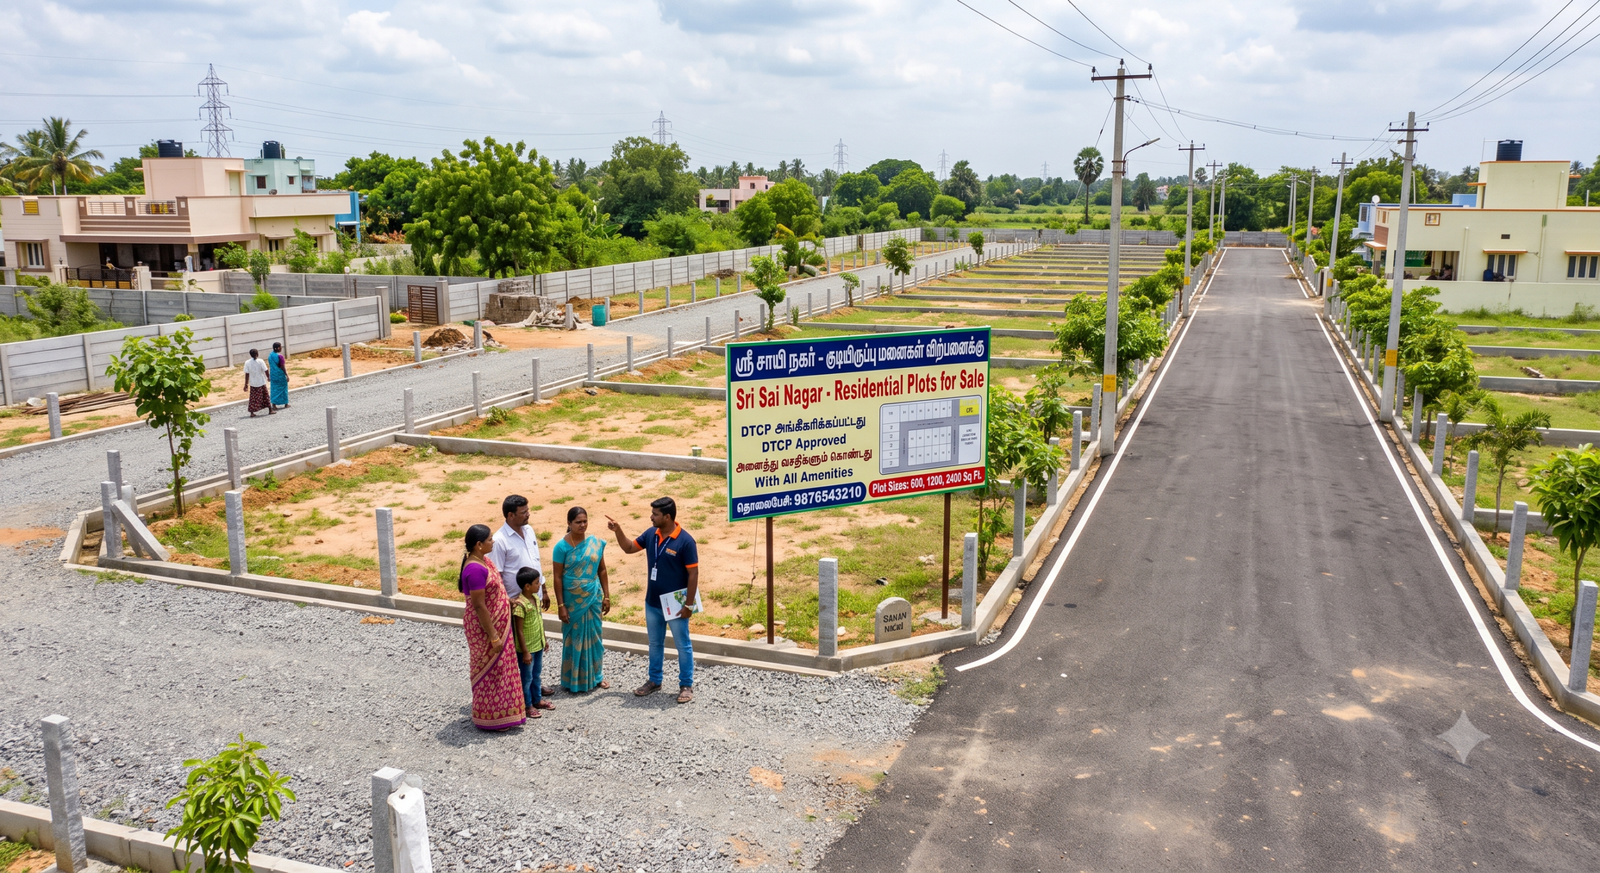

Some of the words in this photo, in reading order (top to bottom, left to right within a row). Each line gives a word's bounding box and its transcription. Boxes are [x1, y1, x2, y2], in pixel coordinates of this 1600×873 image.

[756, 348, 787, 371] சாயி
[788, 346, 816, 374] நகர்
[826, 342, 877, 369] குடியிருப்பு
[878, 339, 925, 361] மனைகள்
[926, 335, 985, 363] விற்பனைக்கு
[736, 387, 755, 410] Sri
[759, 385, 780, 408] Sai
[784, 383, 823, 409] Nagar
[834, 374, 903, 401] Residential
[907, 373, 937, 394] Plots
[940, 370, 957, 391] for
[959, 368, 985, 389] Sale
[741, 423, 771, 437] DTCP
[762, 438, 792, 453] DTCP
[795, 433, 847, 451] Approved
[735, 458, 779, 473] அனைத்து
[754, 475, 780, 488] With
[783, 472, 797, 485] All
[800, 467, 853, 482] Amenities
[872, 482, 887, 494] Plot
[910, 477, 925, 489] 600,
[926, 474, 945, 487] 1200,
[945, 472, 962, 484] 2400
[962, 471, 973, 483] Sq
[794, 485, 862, 506] 9876543210
